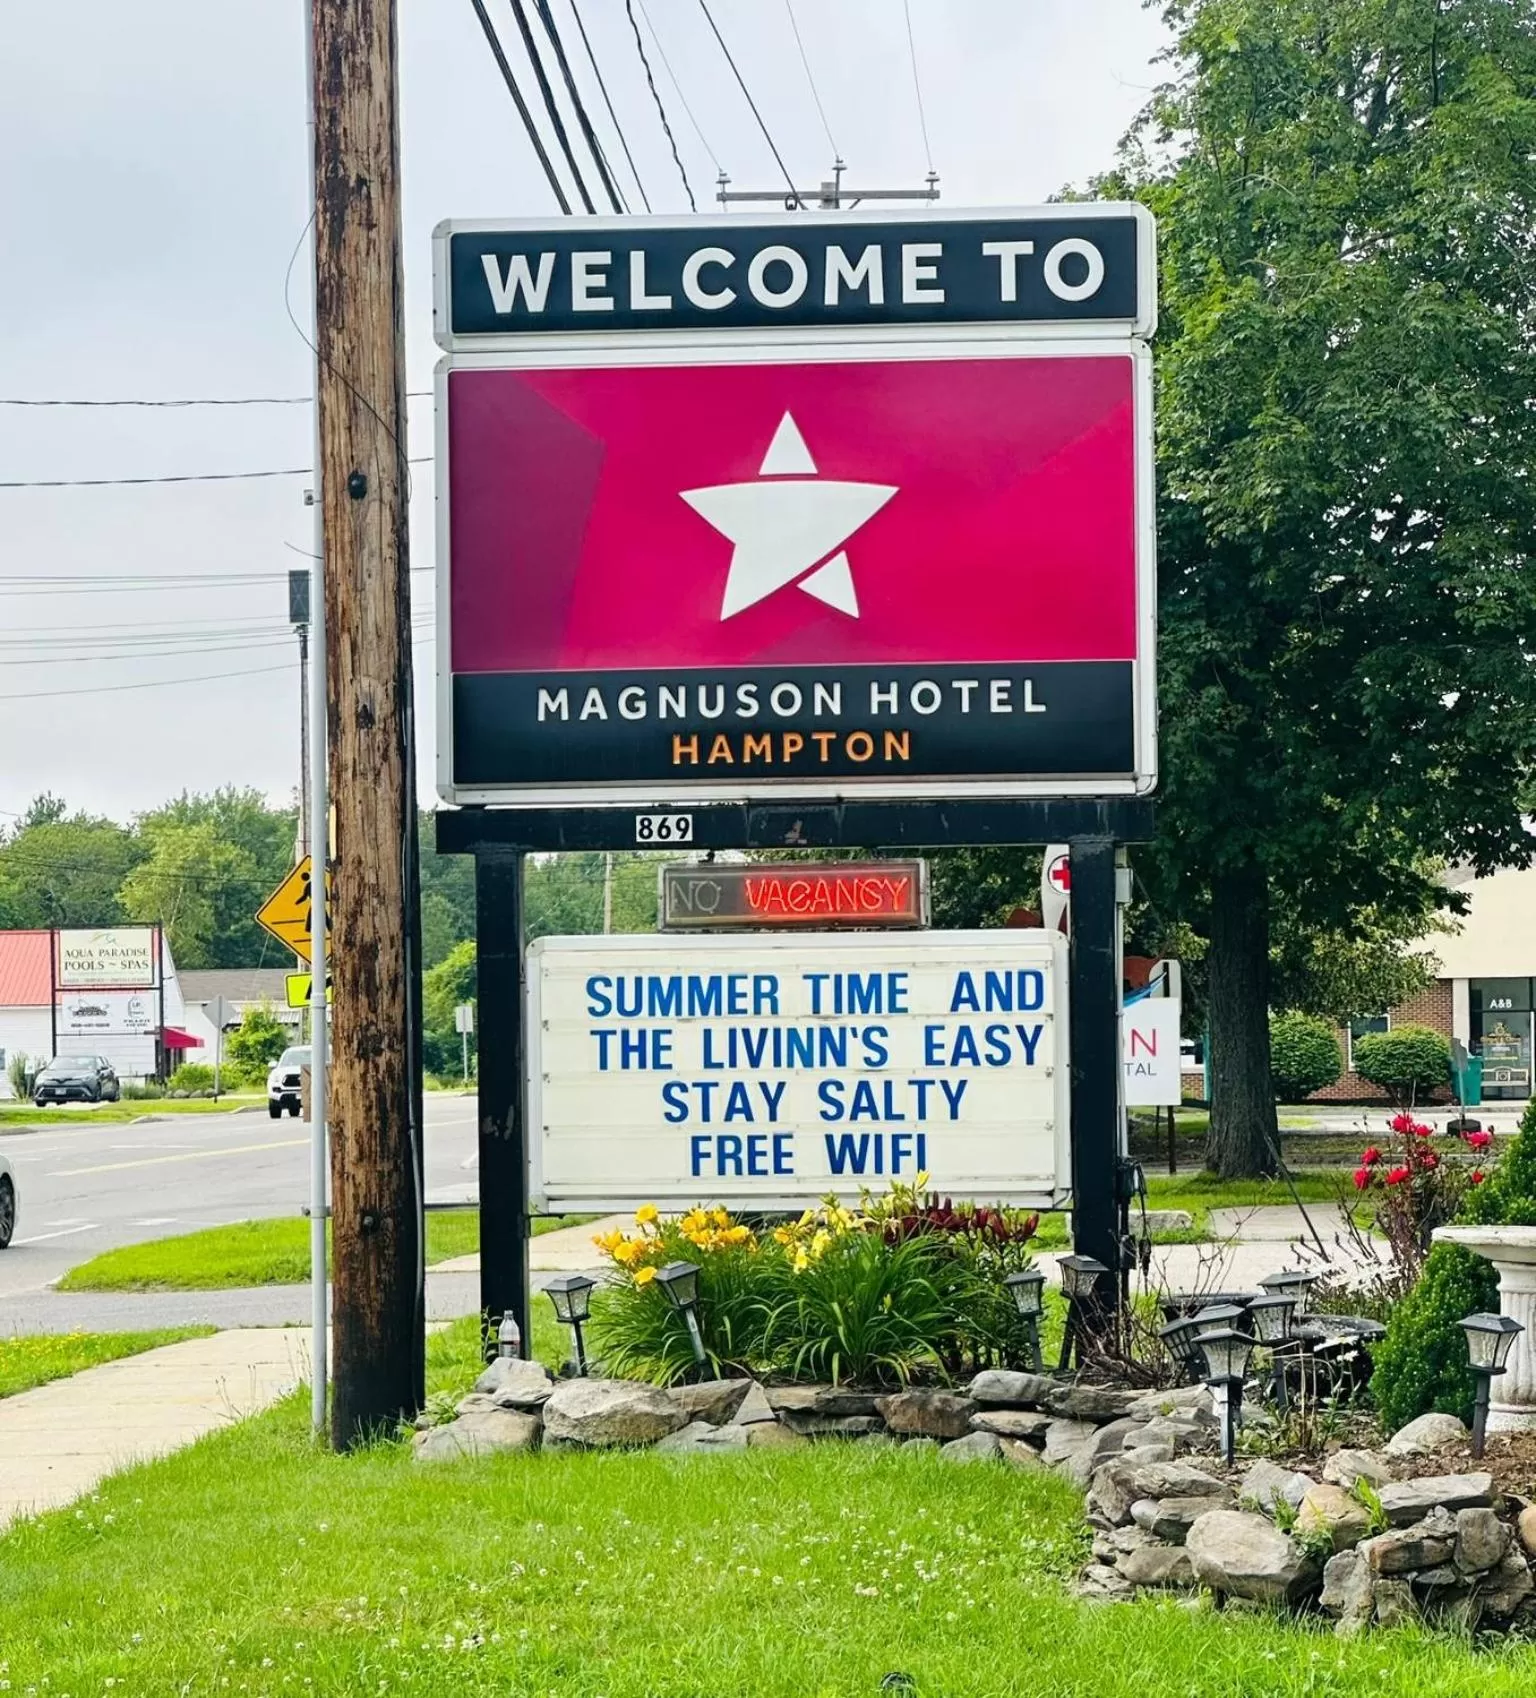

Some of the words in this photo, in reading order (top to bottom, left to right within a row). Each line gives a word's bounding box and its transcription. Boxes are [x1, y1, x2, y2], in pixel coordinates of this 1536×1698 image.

[480, 243, 946, 313] WELCOME
[982, 238, 1105, 302] TO
[537, 681, 842, 722] MAGNUSON
[870, 679, 1047, 715] HOTEL
[671, 731, 911, 765] HAMPTON
[638, 817, 690, 840] 869
[670, 879, 722, 914] NO
[744, 876, 909, 913] VACANCY
[64, 960, 105, 971] POOLS
[120, 960, 149, 970] SPAS
[65, 948, 94, 959] AQUA
[98, 948, 149, 958] PARADISE
[586, 974, 779, 1017] SUMMER
[802, 972, 909, 1015] TIME
[950, 970, 1044, 1013] AND
[1489, 999, 1513, 1009] A&B
[591, 1028, 673, 1071] THE
[703, 1025, 889, 1069] LIVINN'S
[924, 1023, 1043, 1067] EASY
[1123, 1028, 1157, 1057] N
[662, 1080, 786, 1123] STAY
[818, 1079, 968, 1121] SALTY
[691, 1133, 794, 1177] FREE
[825, 1133, 926, 1176] WIFI
